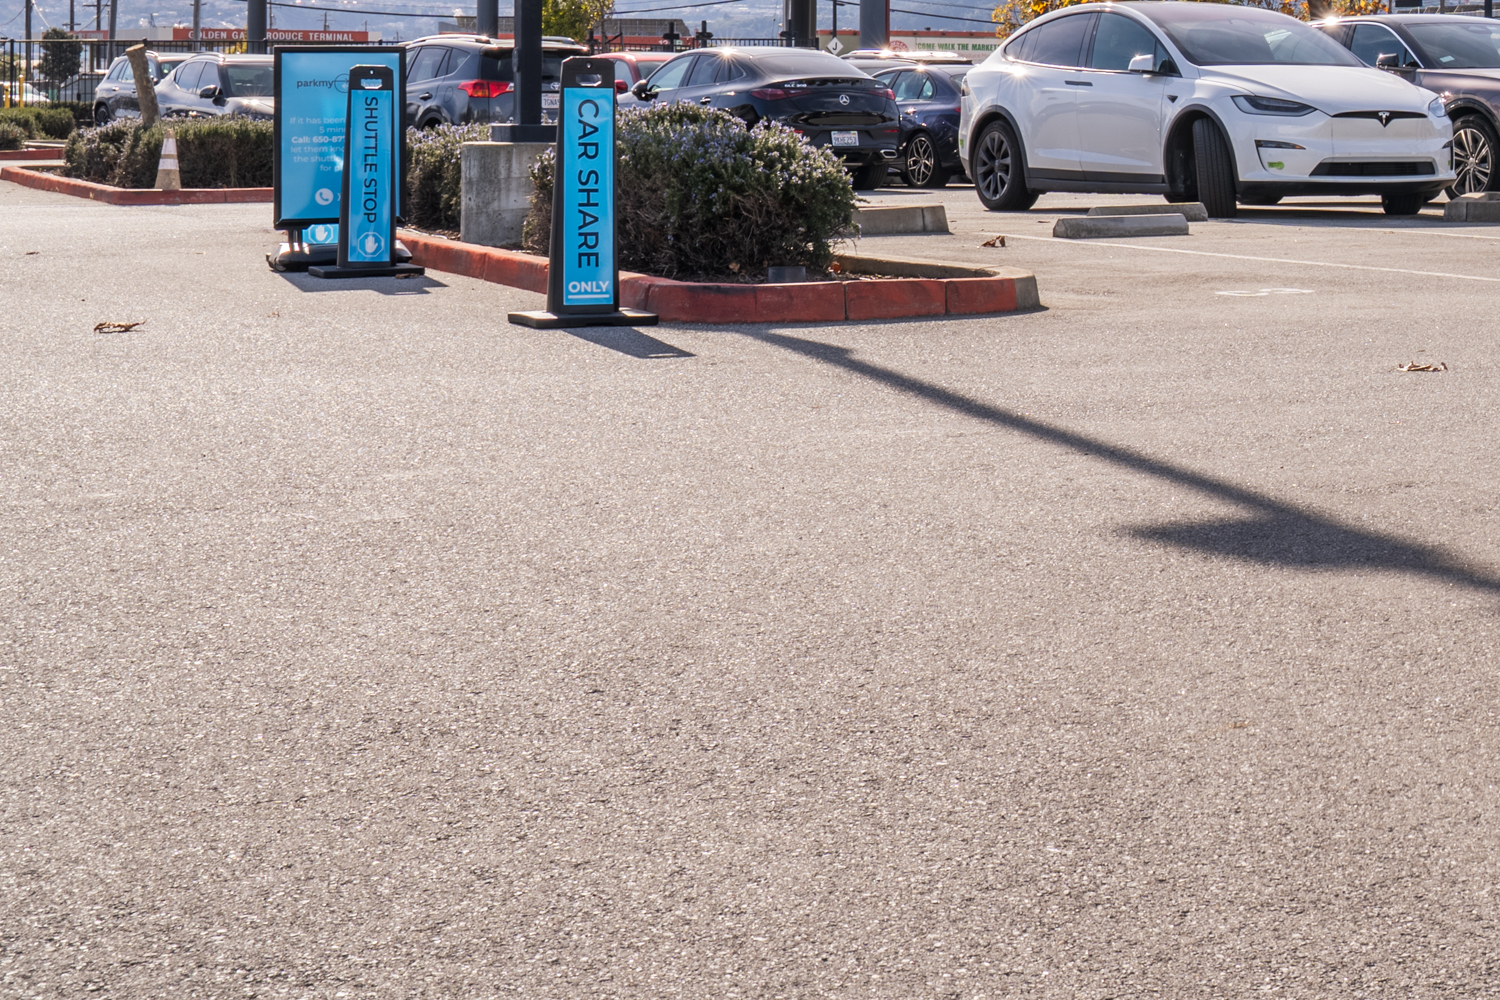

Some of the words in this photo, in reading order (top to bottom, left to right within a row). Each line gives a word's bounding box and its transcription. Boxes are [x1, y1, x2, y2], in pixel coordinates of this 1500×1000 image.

[266, 31, 303, 40] RODUCE
[308, 32, 354, 41] TERMINAL
[832, 42, 838, 50] J
[957, 43, 969, 51] THE
[296, 78, 335, 89] parkmy
[364, 96, 378, 173] SHUTTLE
[578, 99, 599, 160] CAR
[291, 136, 311, 144] Call:
[290, 145, 302, 153] let
[303, 145, 328, 153] them
[320, 164, 332, 172] for
[363, 178, 377, 223] STOP
[578, 169, 599, 268] SHARE
[568, 281, 610, 293] ONLY
